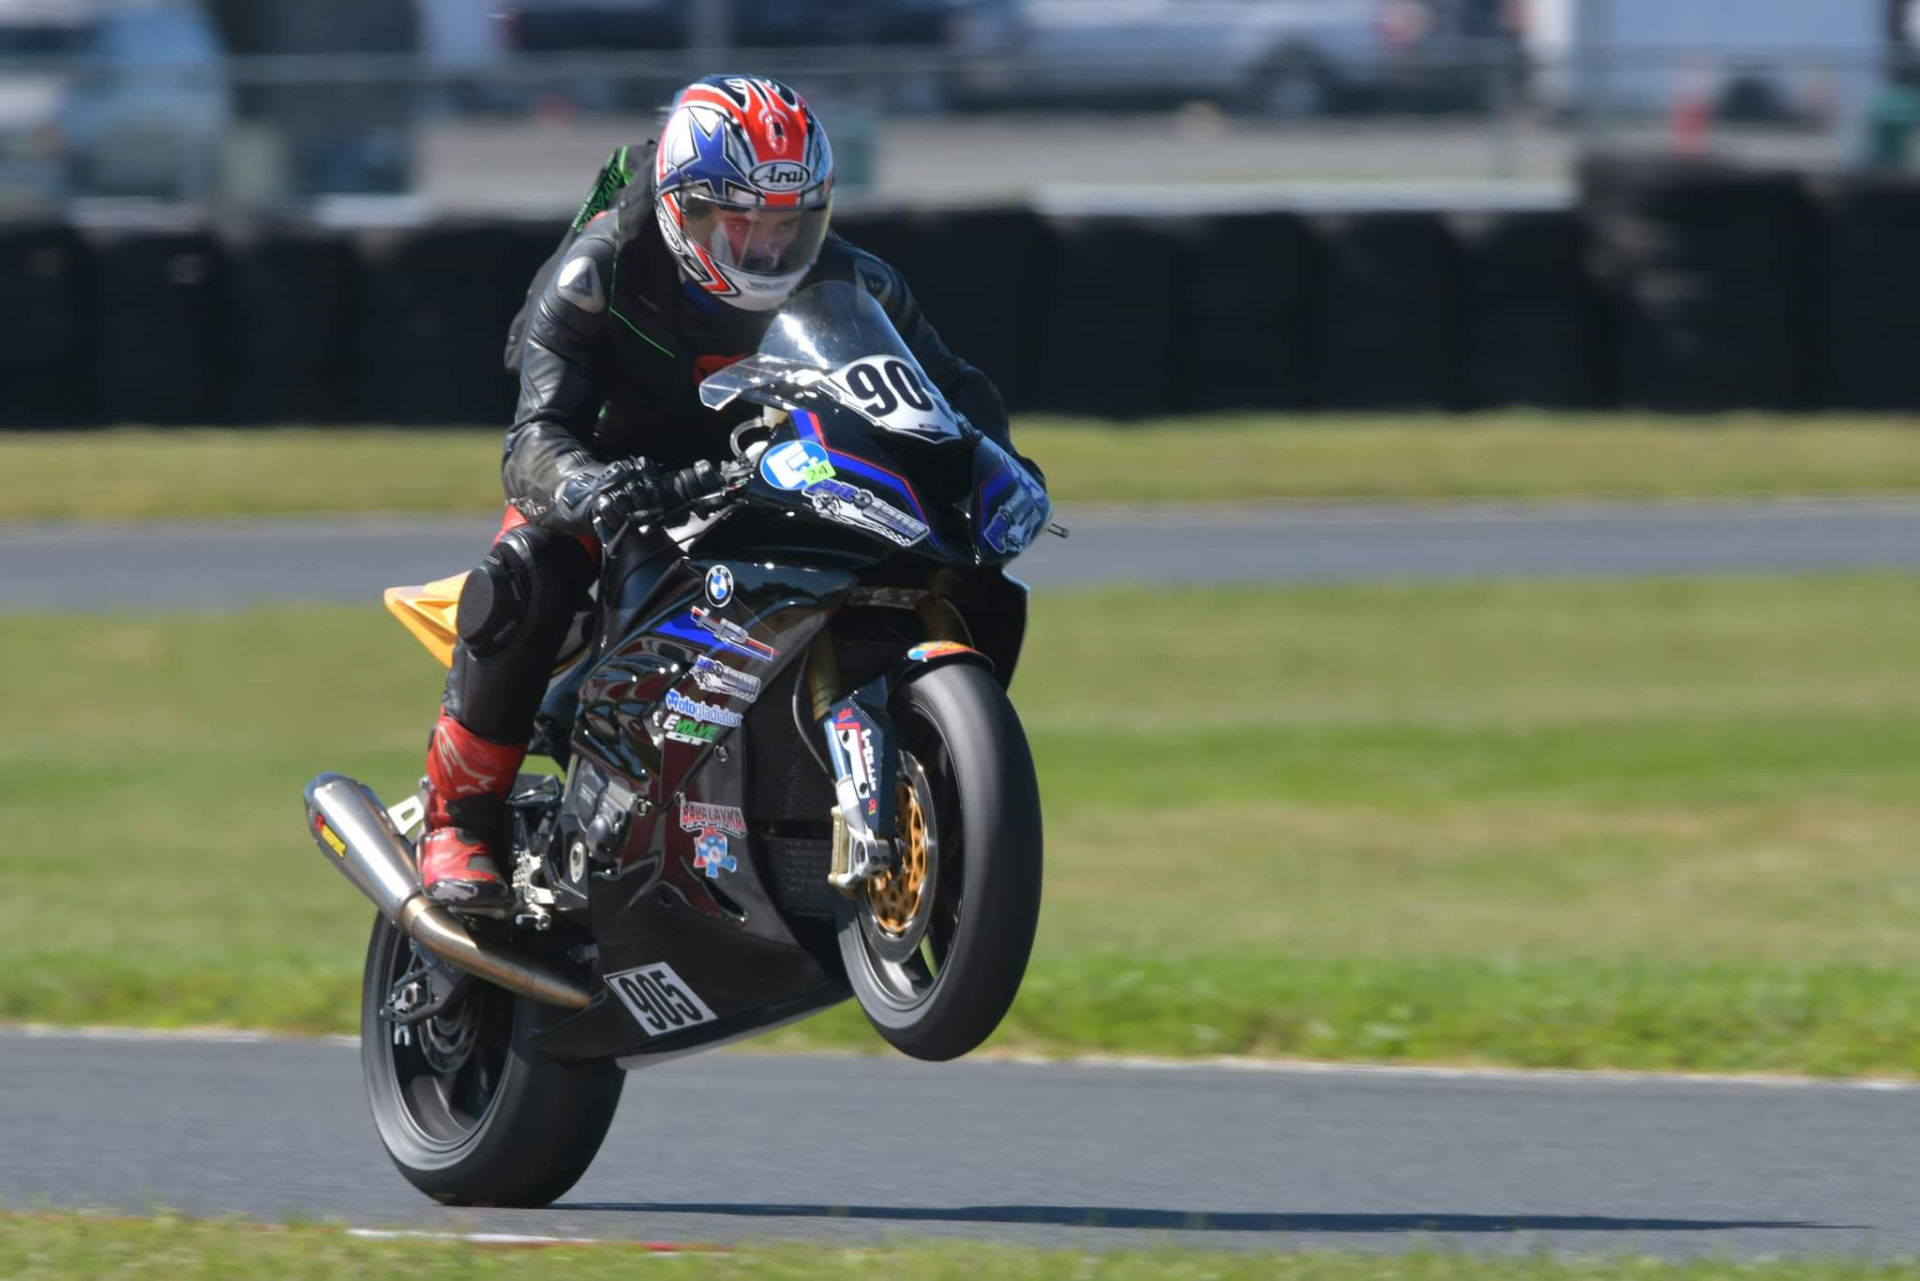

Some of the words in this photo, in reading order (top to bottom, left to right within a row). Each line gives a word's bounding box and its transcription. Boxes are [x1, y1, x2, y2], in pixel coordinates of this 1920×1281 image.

[754, 165, 804, 183] Arai
[663, 713, 720, 740] EVOLVE
[617, 969, 704, 1031] 905
